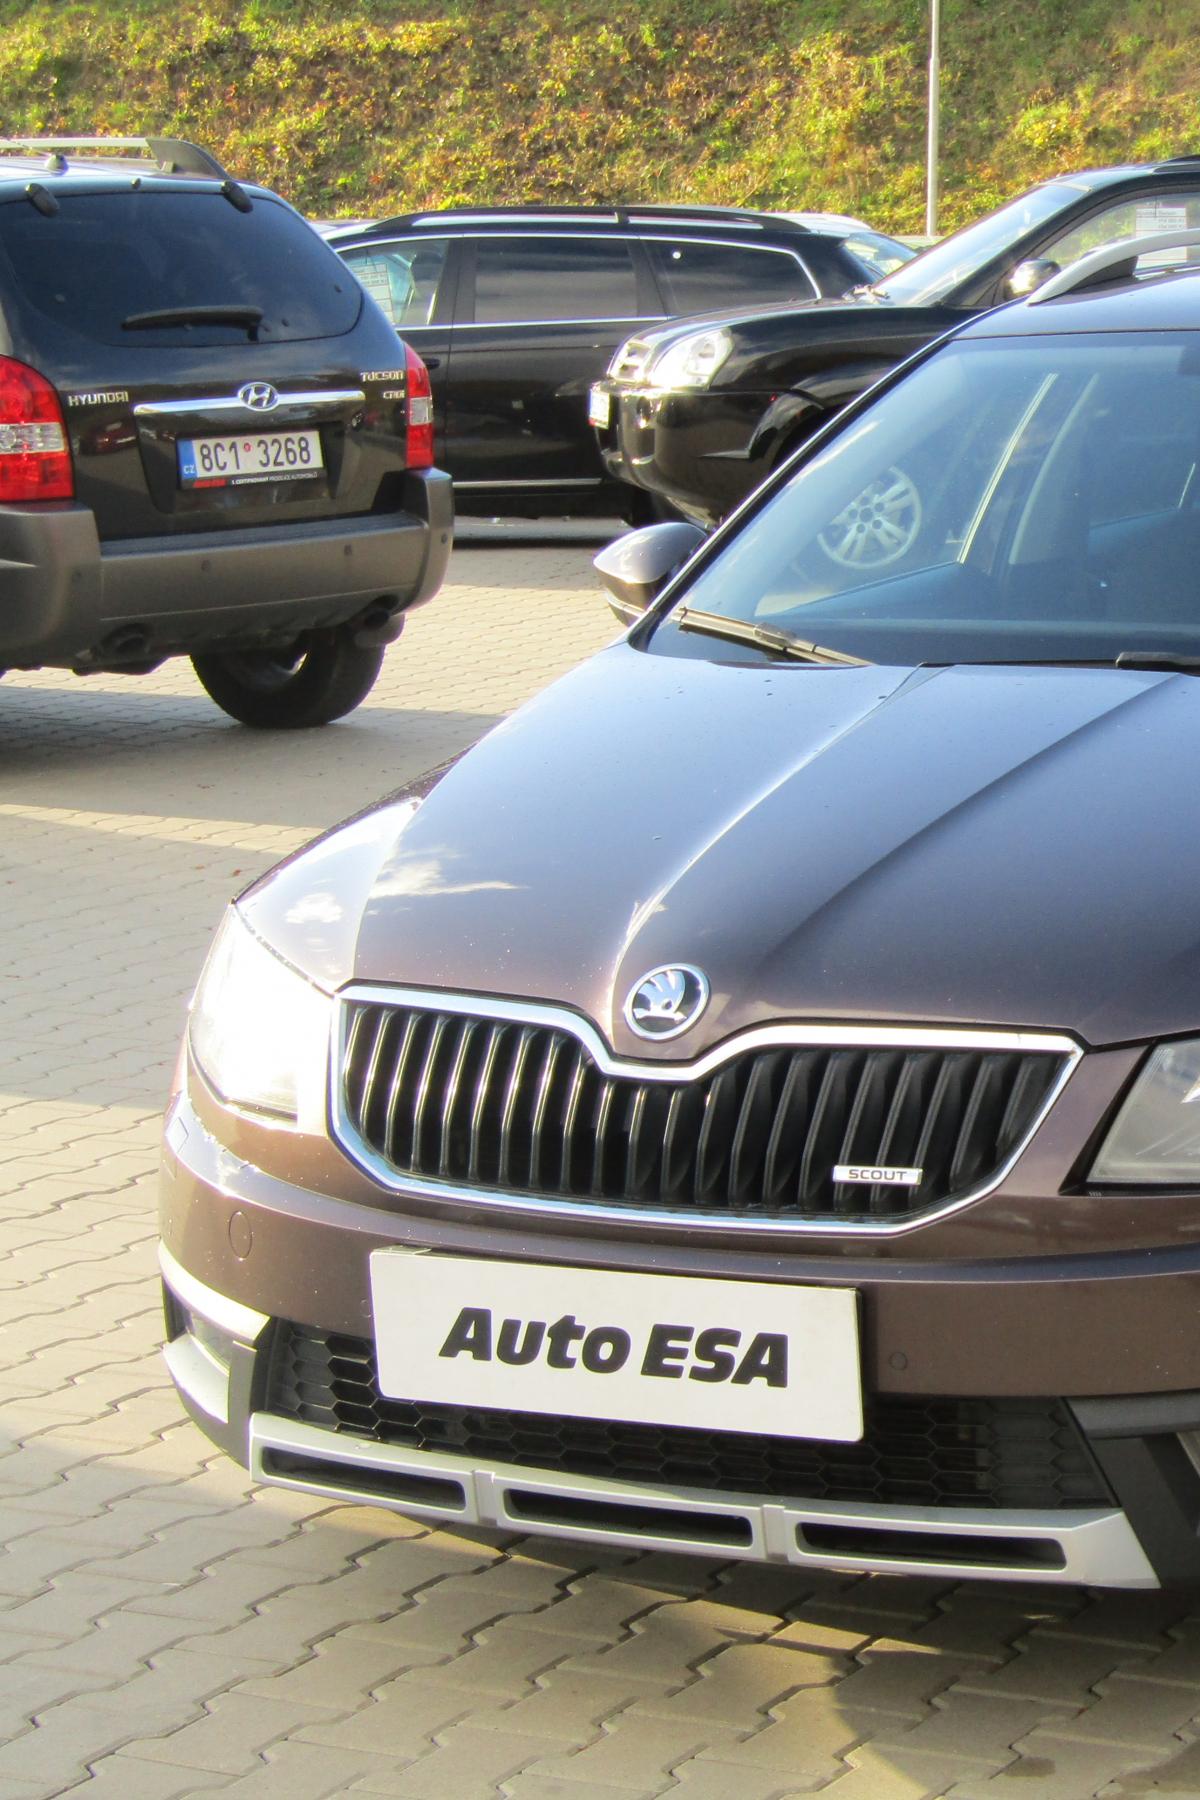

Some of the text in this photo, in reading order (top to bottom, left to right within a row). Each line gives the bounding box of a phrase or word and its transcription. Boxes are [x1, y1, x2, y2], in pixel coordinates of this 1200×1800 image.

[68, 391, 129, 407] HYUNDAI
[200, 436, 311, 472] 8C1 3268
[848, 1168, 907, 1181] SCOUT
[438, 1307, 789, 1388] Auto ESA
